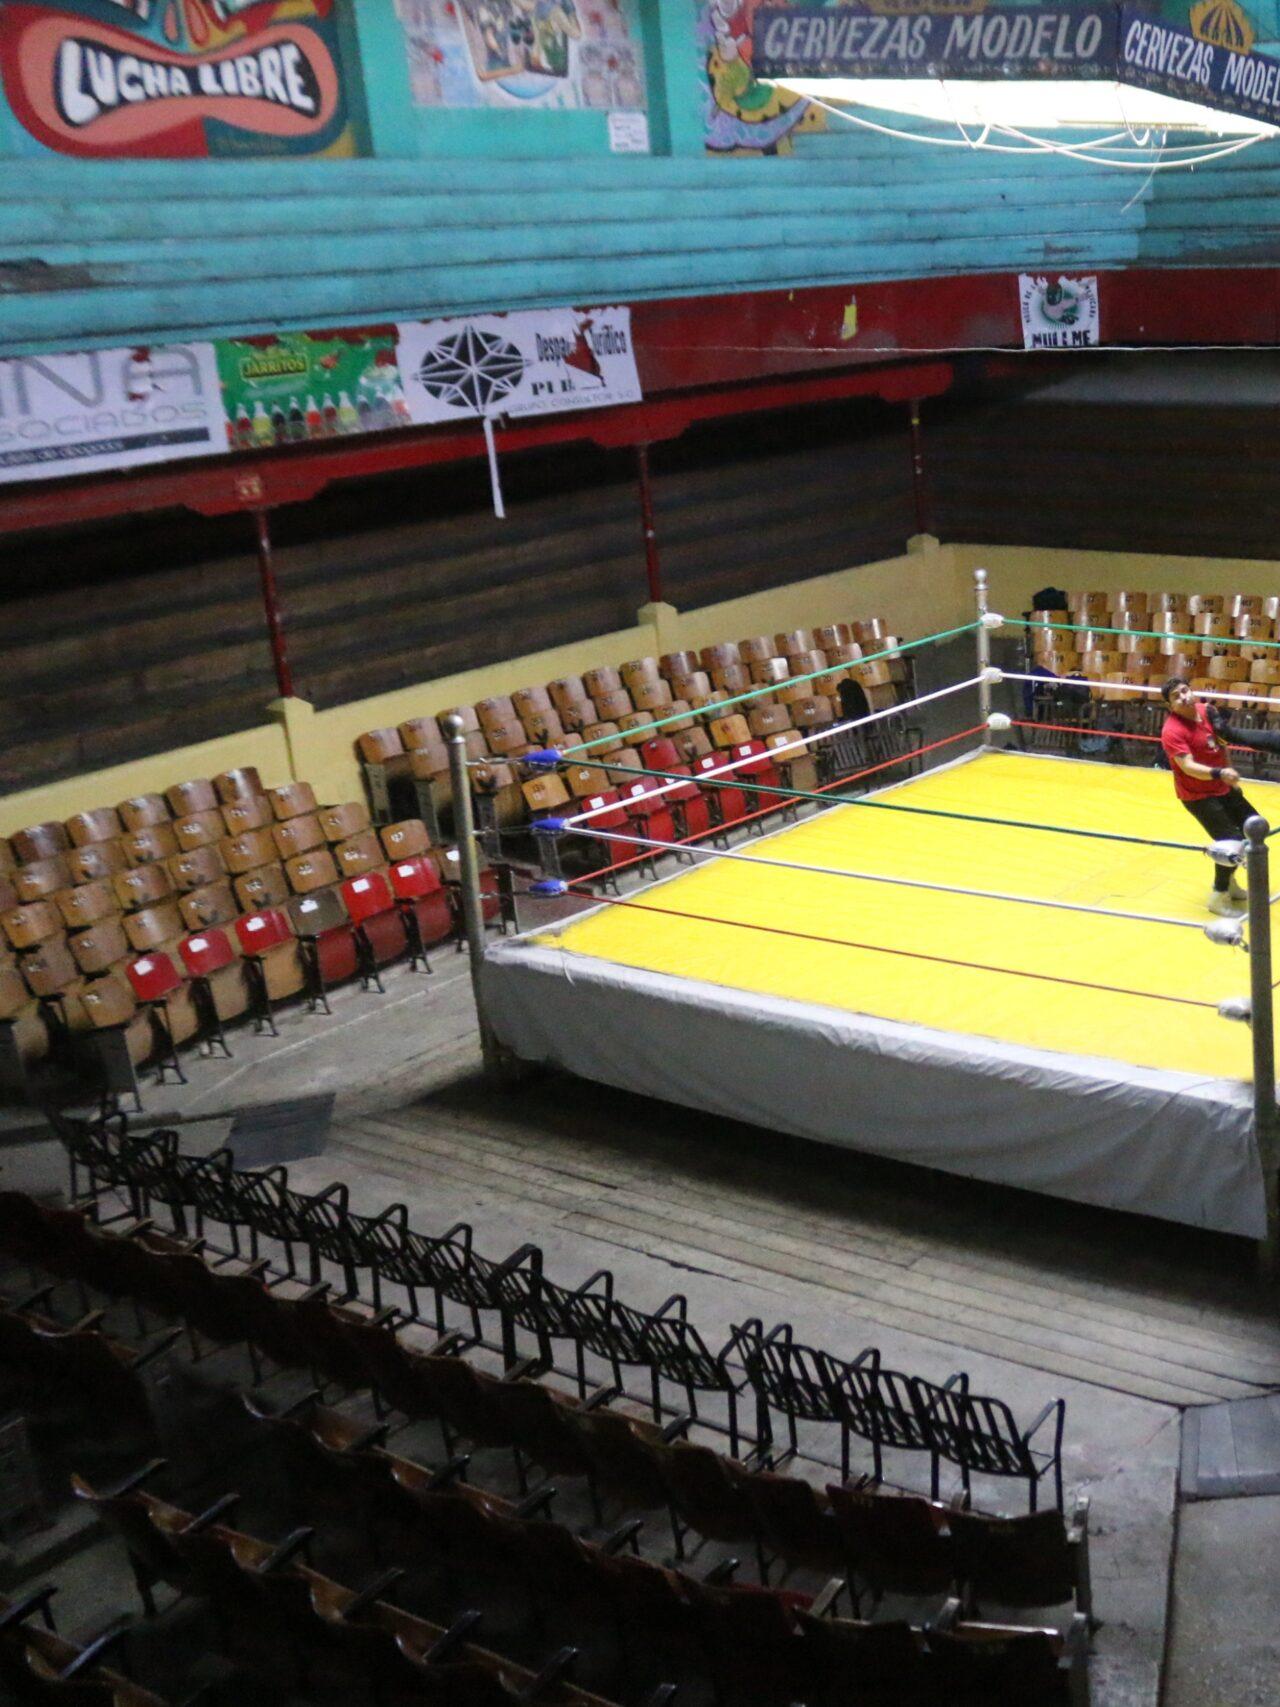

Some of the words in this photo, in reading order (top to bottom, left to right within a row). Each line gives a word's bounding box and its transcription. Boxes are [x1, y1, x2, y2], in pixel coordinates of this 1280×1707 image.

[763, 14, 932, 60] CERVEZAS
[943, 13, 1105, 61] MODELO
[1123, 19, 1215, 86] CERVEZAS
[60, 38, 192, 125] LUCHA
[197, 41, 316, 113] LIBRE
[0, 346, 203, 418] NA
[244, 359, 306, 377] JARRITOS
